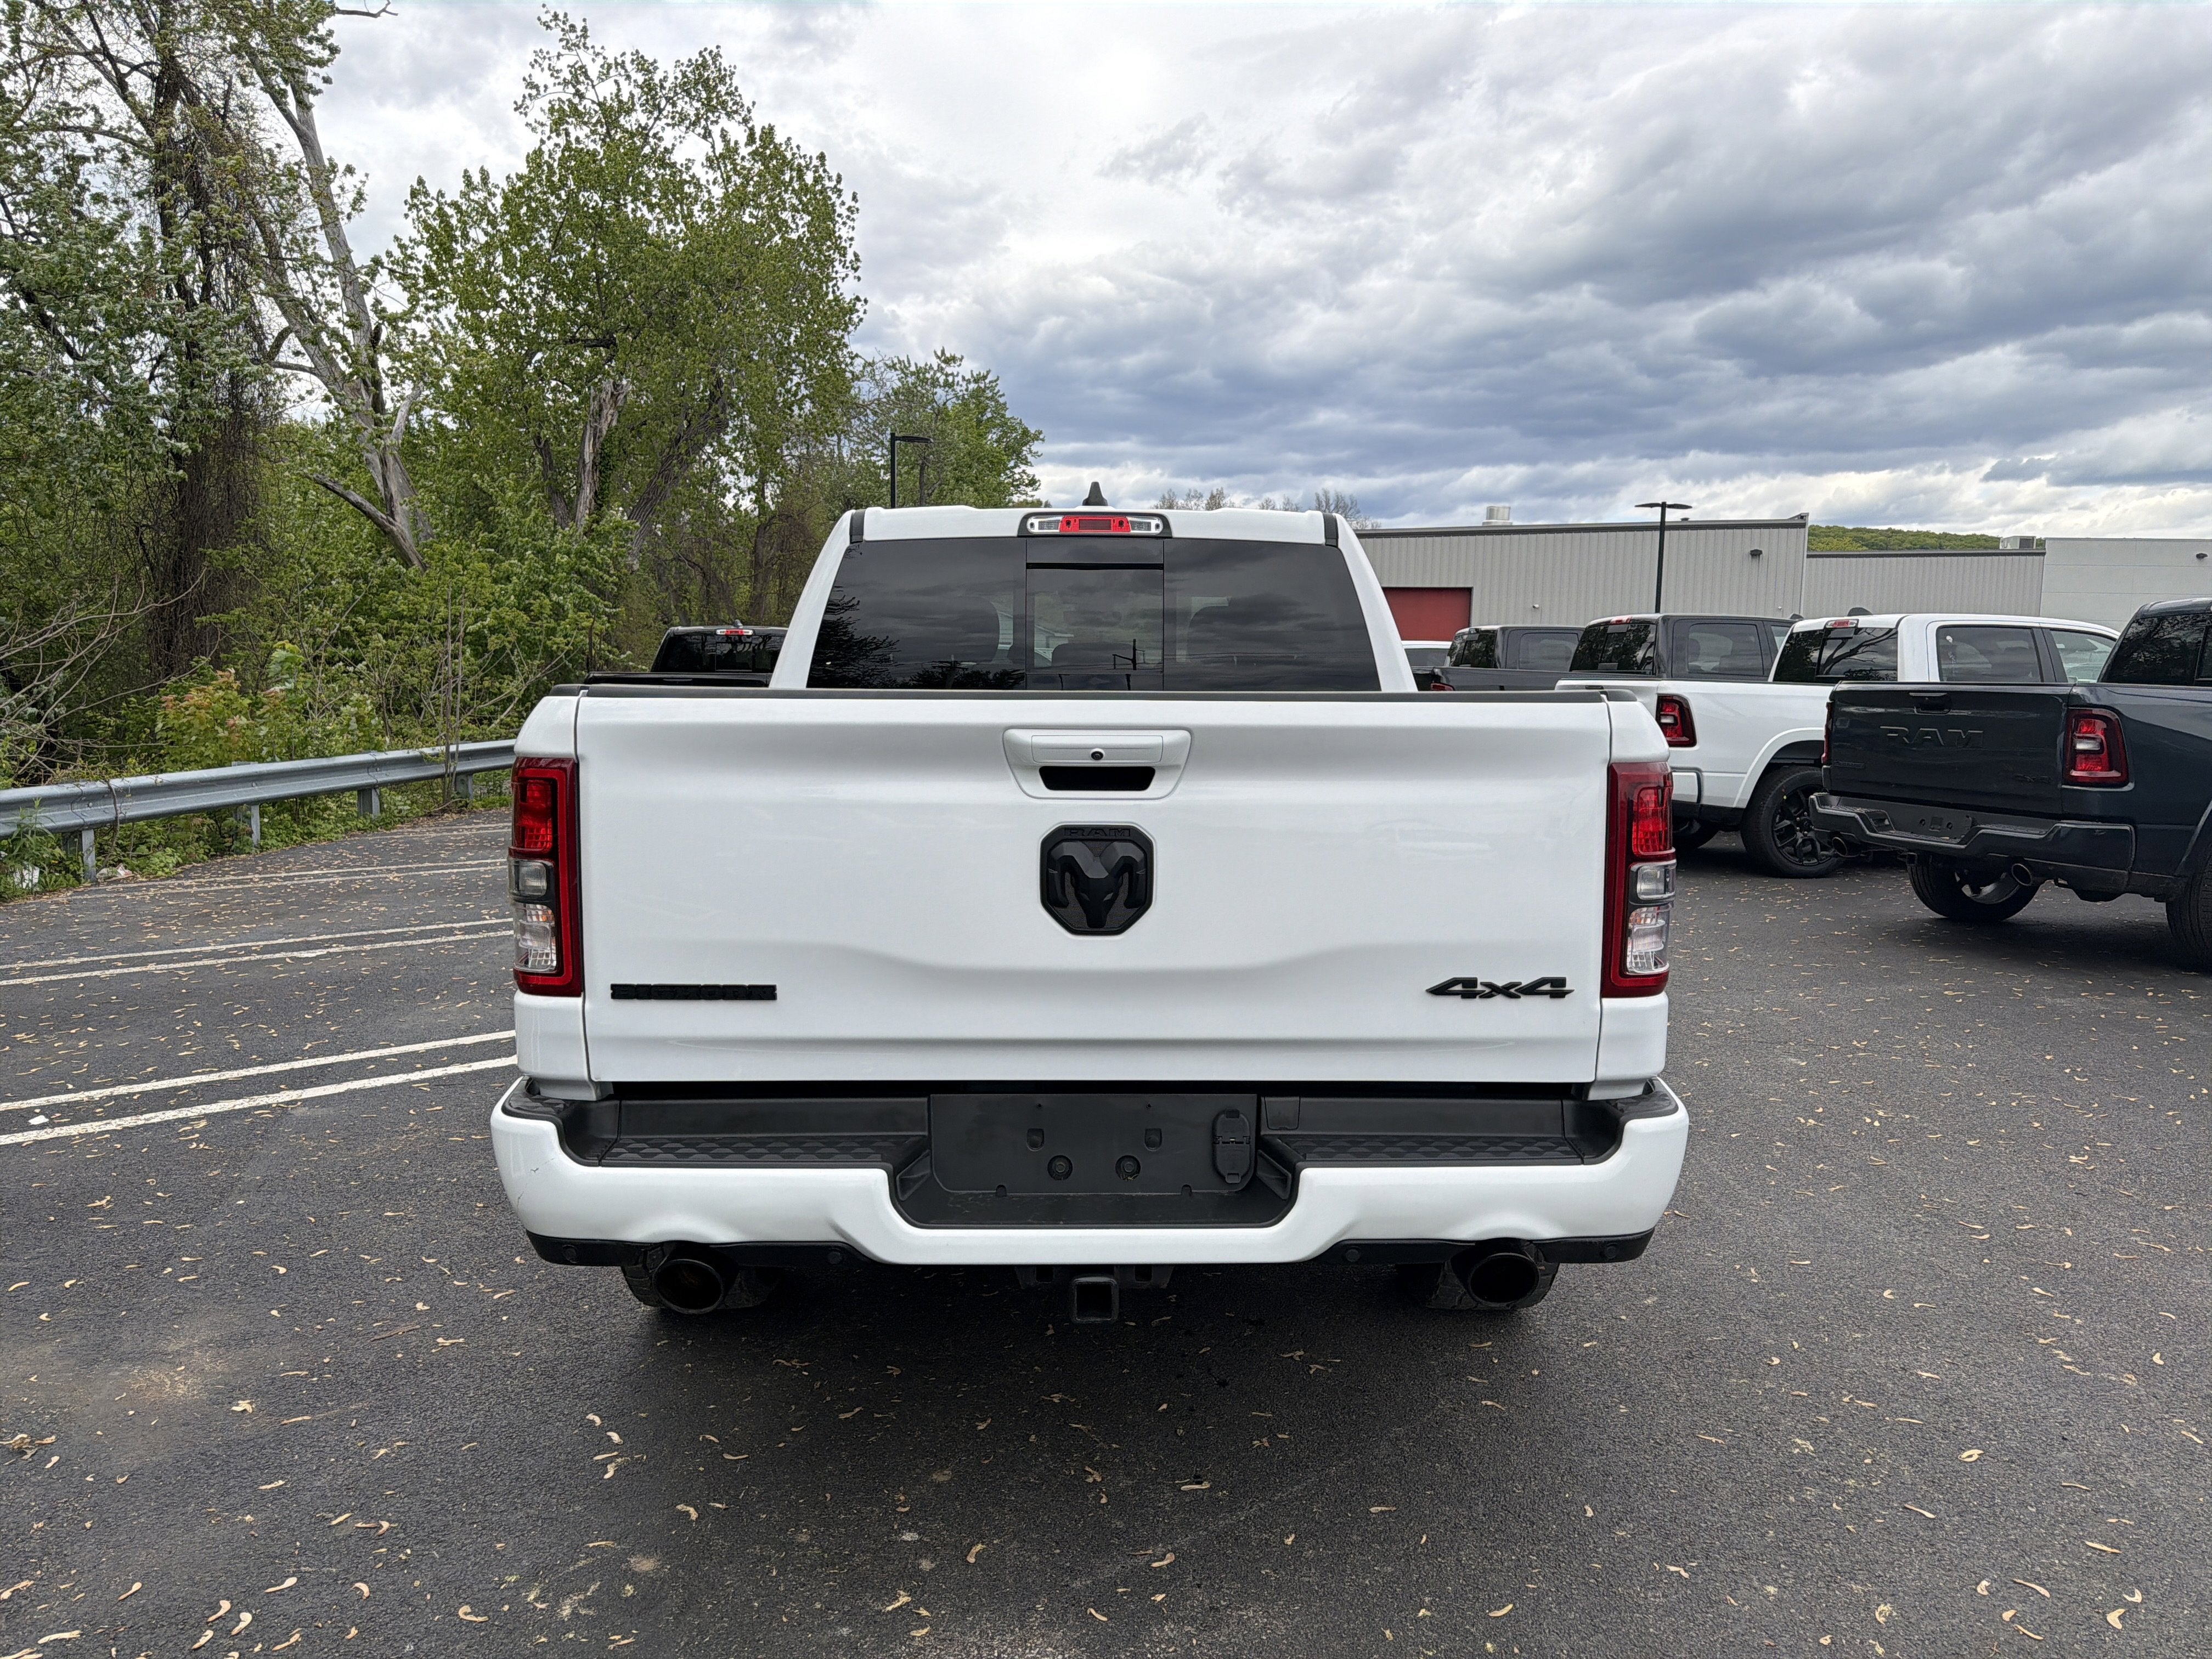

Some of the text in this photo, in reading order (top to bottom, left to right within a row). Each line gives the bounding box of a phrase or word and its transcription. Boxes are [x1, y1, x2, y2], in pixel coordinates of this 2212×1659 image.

[1880, 726, 1983, 748] RAM
[1064, 827, 1131, 837] RAM
[1425, 977, 1575, 999] 4x4
